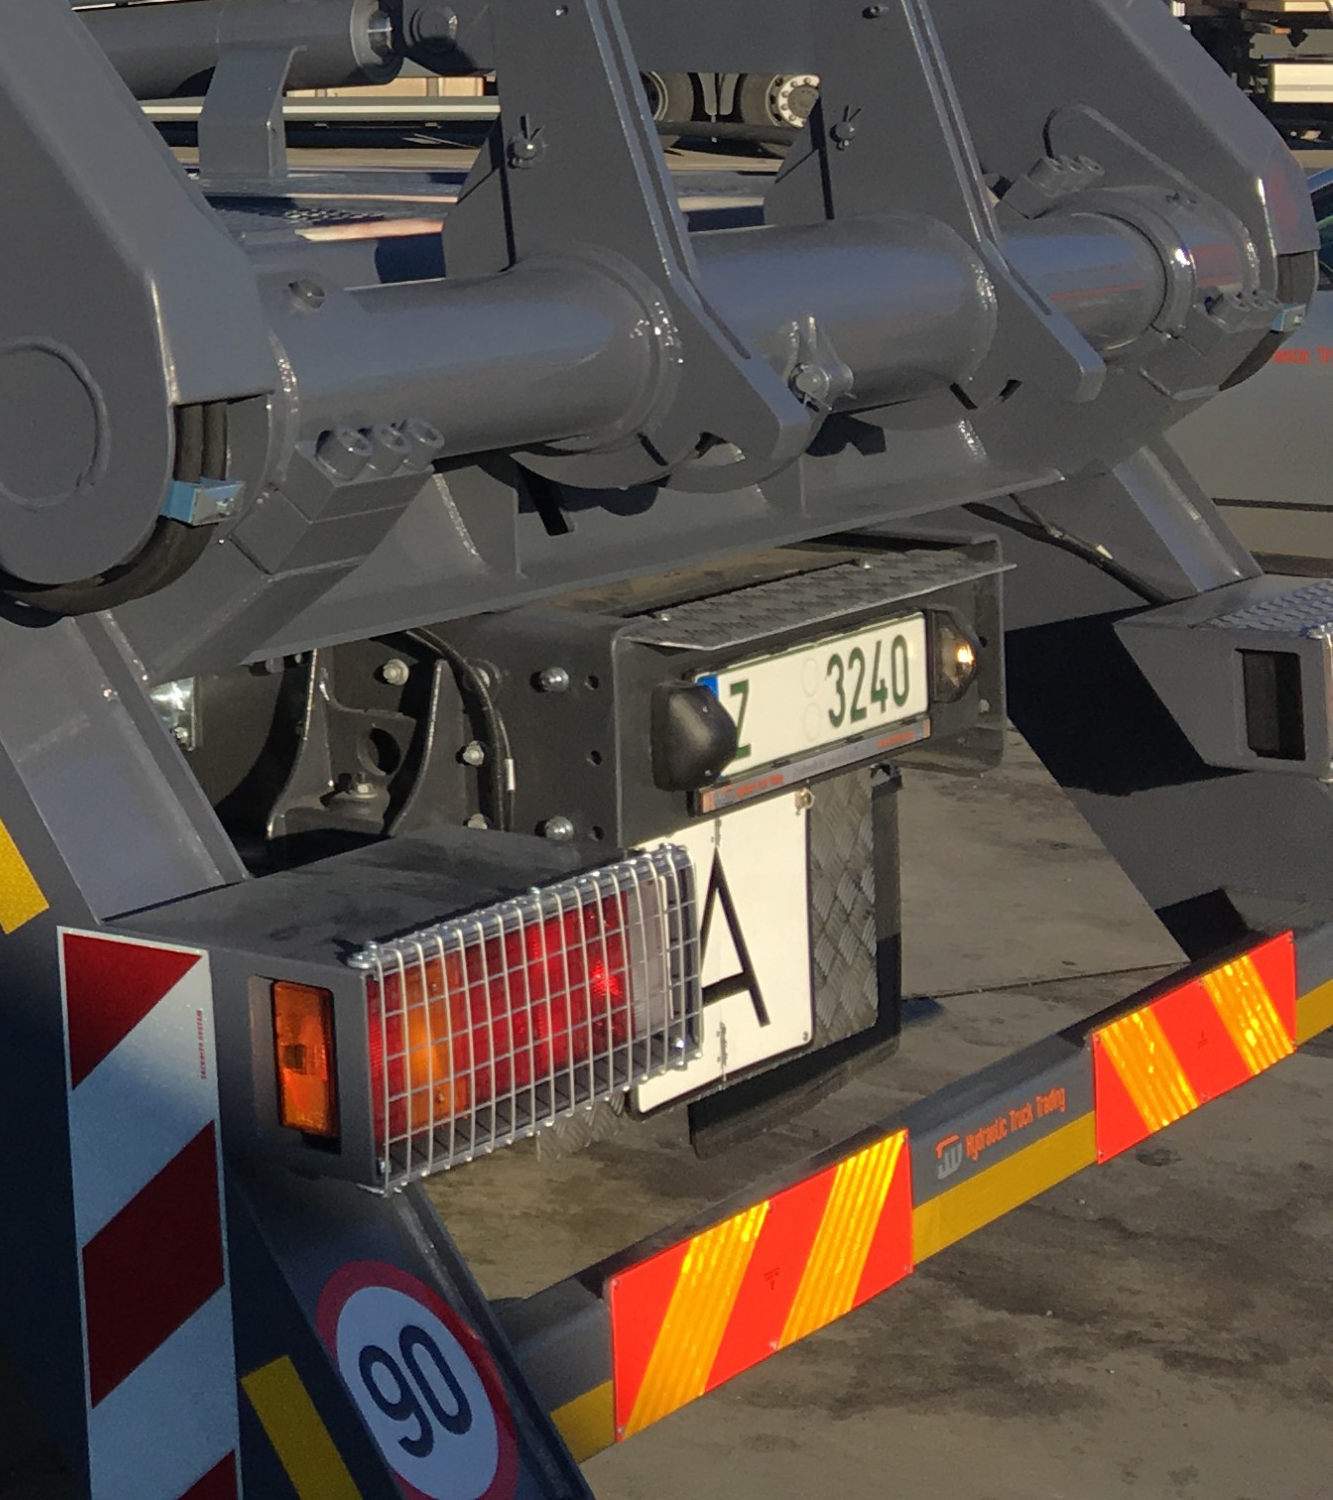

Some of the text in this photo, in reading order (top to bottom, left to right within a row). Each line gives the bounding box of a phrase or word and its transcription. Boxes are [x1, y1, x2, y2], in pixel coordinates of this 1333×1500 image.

[827, 634, 910, 729] 3240
[700, 846, 771, 1028] A
[965, 1087, 1066, 1161] Hydraulic Truck Trading
[358, 1324, 473, 1459] 90
